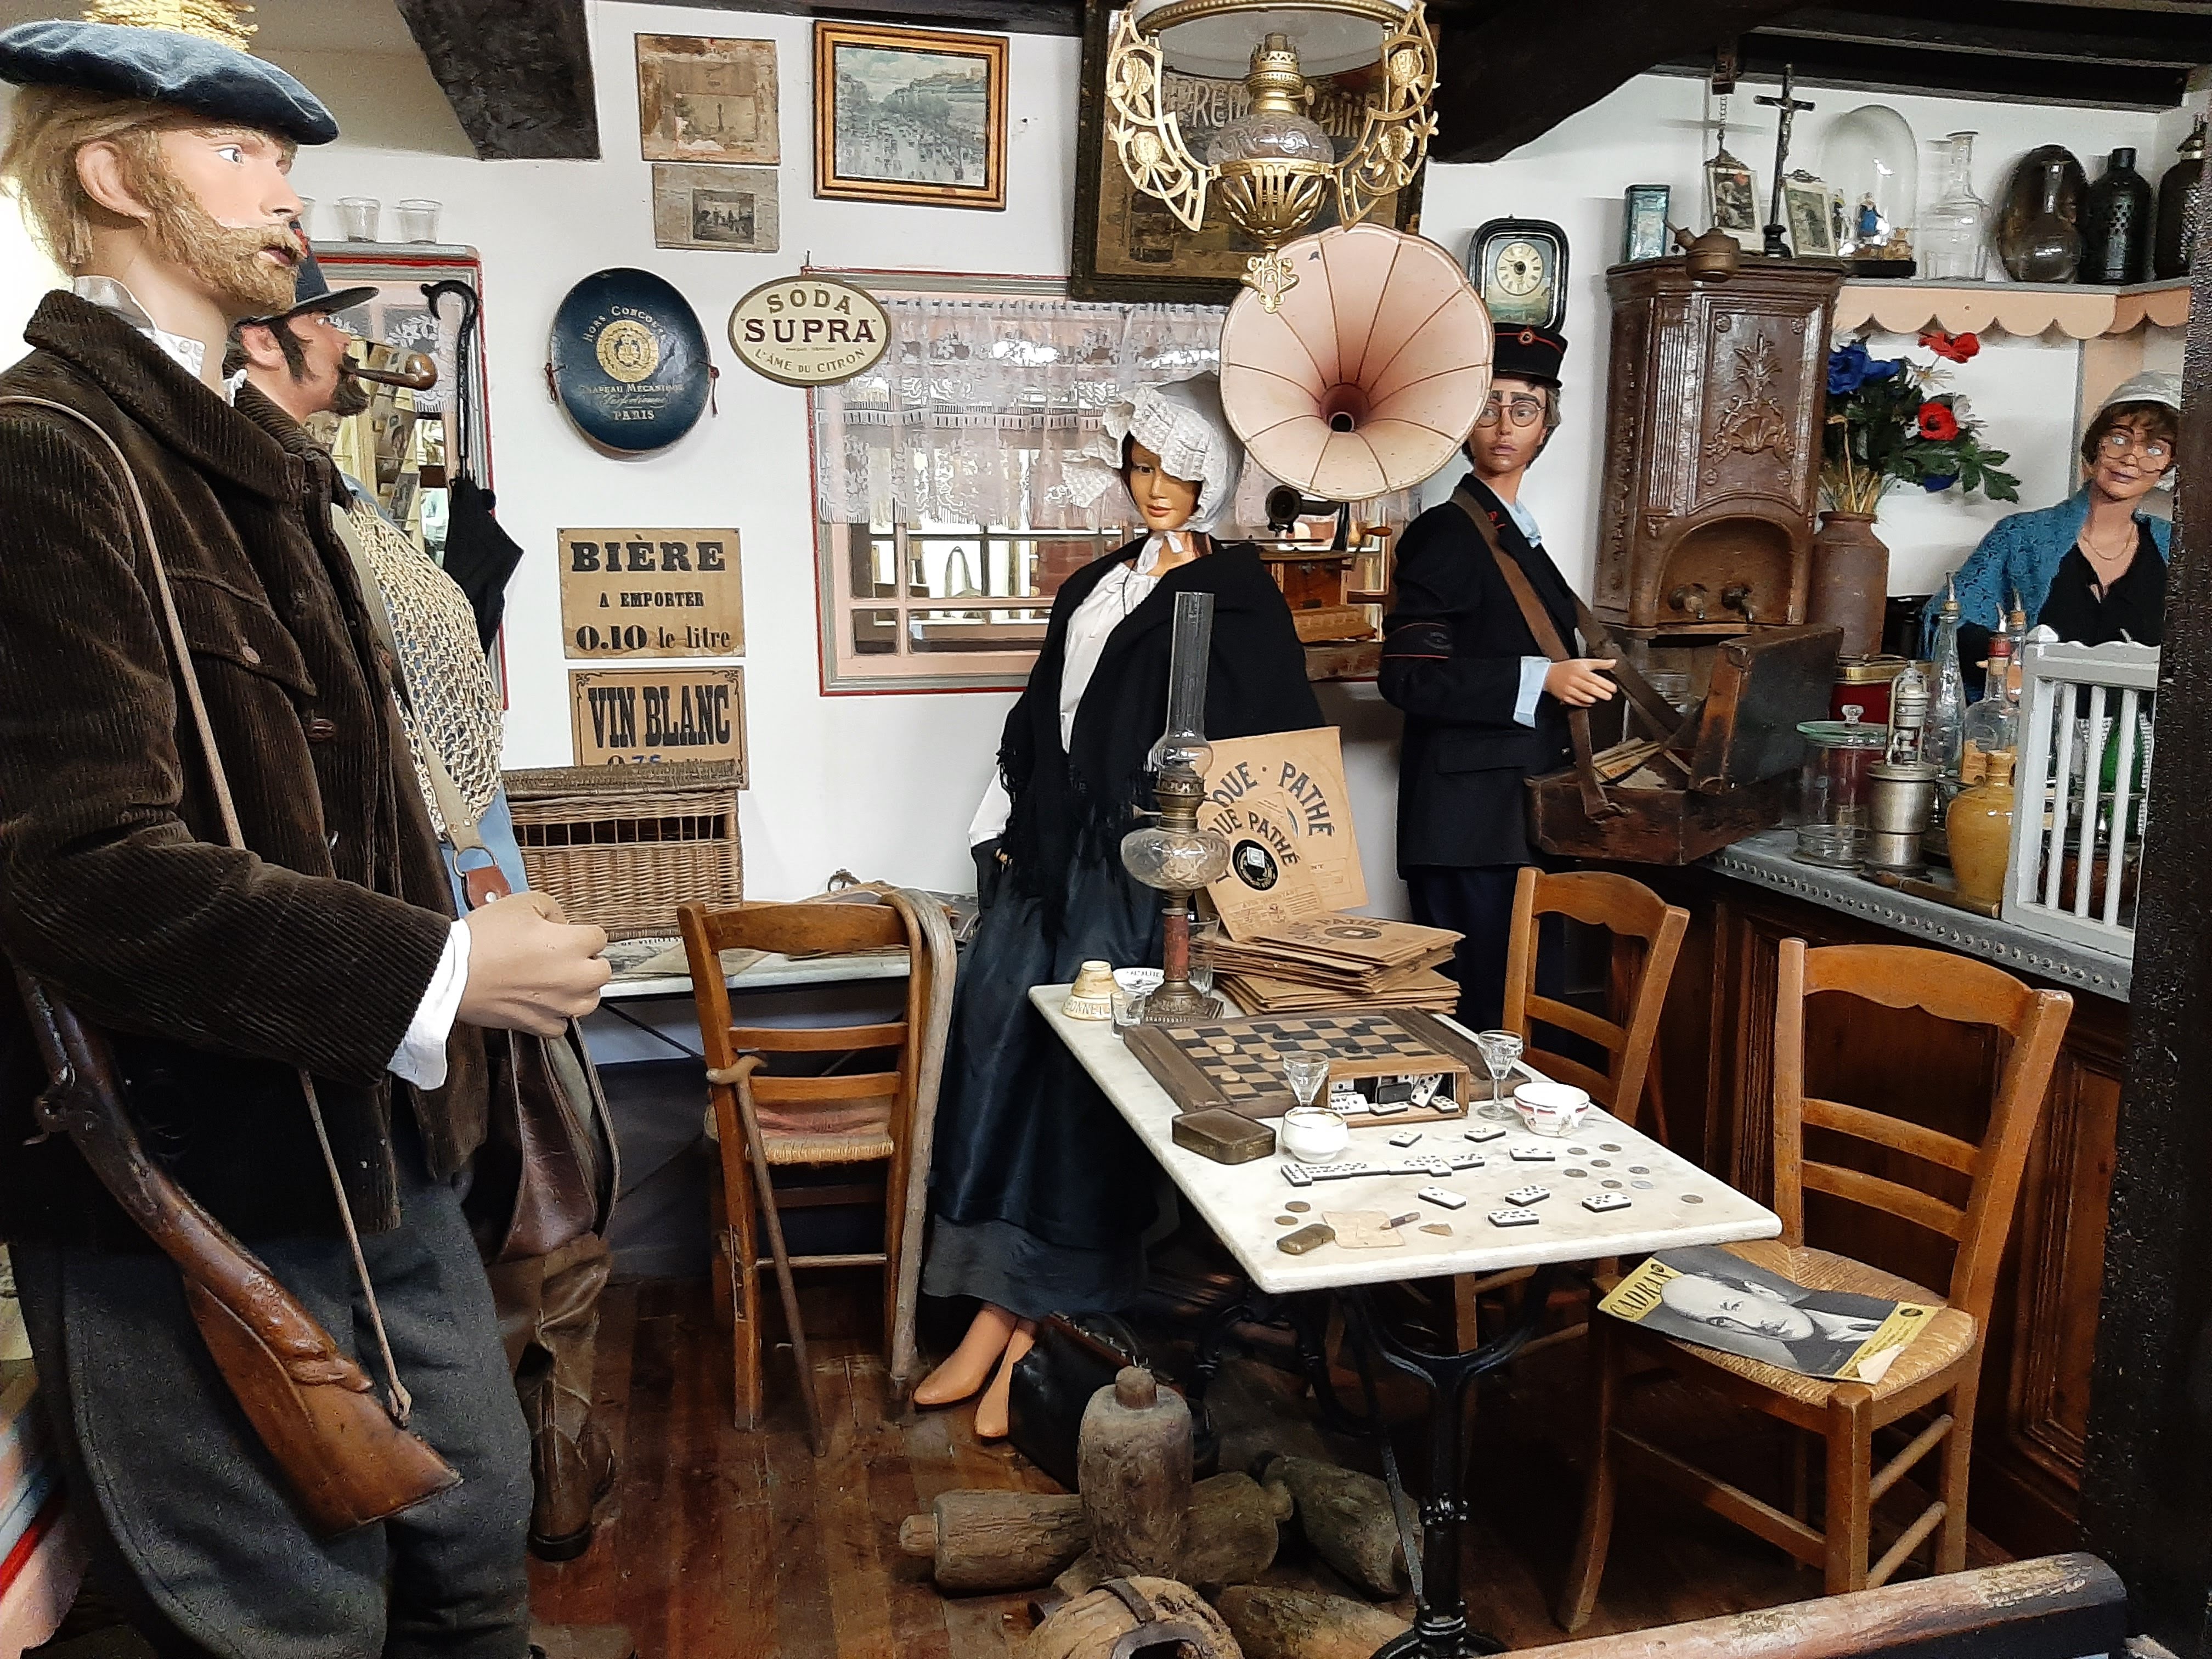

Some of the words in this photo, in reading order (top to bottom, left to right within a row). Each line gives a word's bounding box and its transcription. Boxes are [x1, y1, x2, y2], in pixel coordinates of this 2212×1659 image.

[766, 289, 851, 315] SODA
[798, 364, 811, 373] DU
[817, 348, 866, 373] CITRON
[613, 410, 656, 420] PARIS
[571, 533, 726, 572] BIÈRE
[599, 592, 610, 607] A
[620, 592, 704, 607] EMPORTER
[576, 625, 648, 650] 0.10
[659, 625, 675, 648] le
[686, 624, 730, 648] litre
[588, 686, 637, 748] VIN
[642, 684, 731, 747] BLANC
[1278, 760, 1335, 837] PATHÉ
[1247, 810, 1301, 867] PATHÉ
